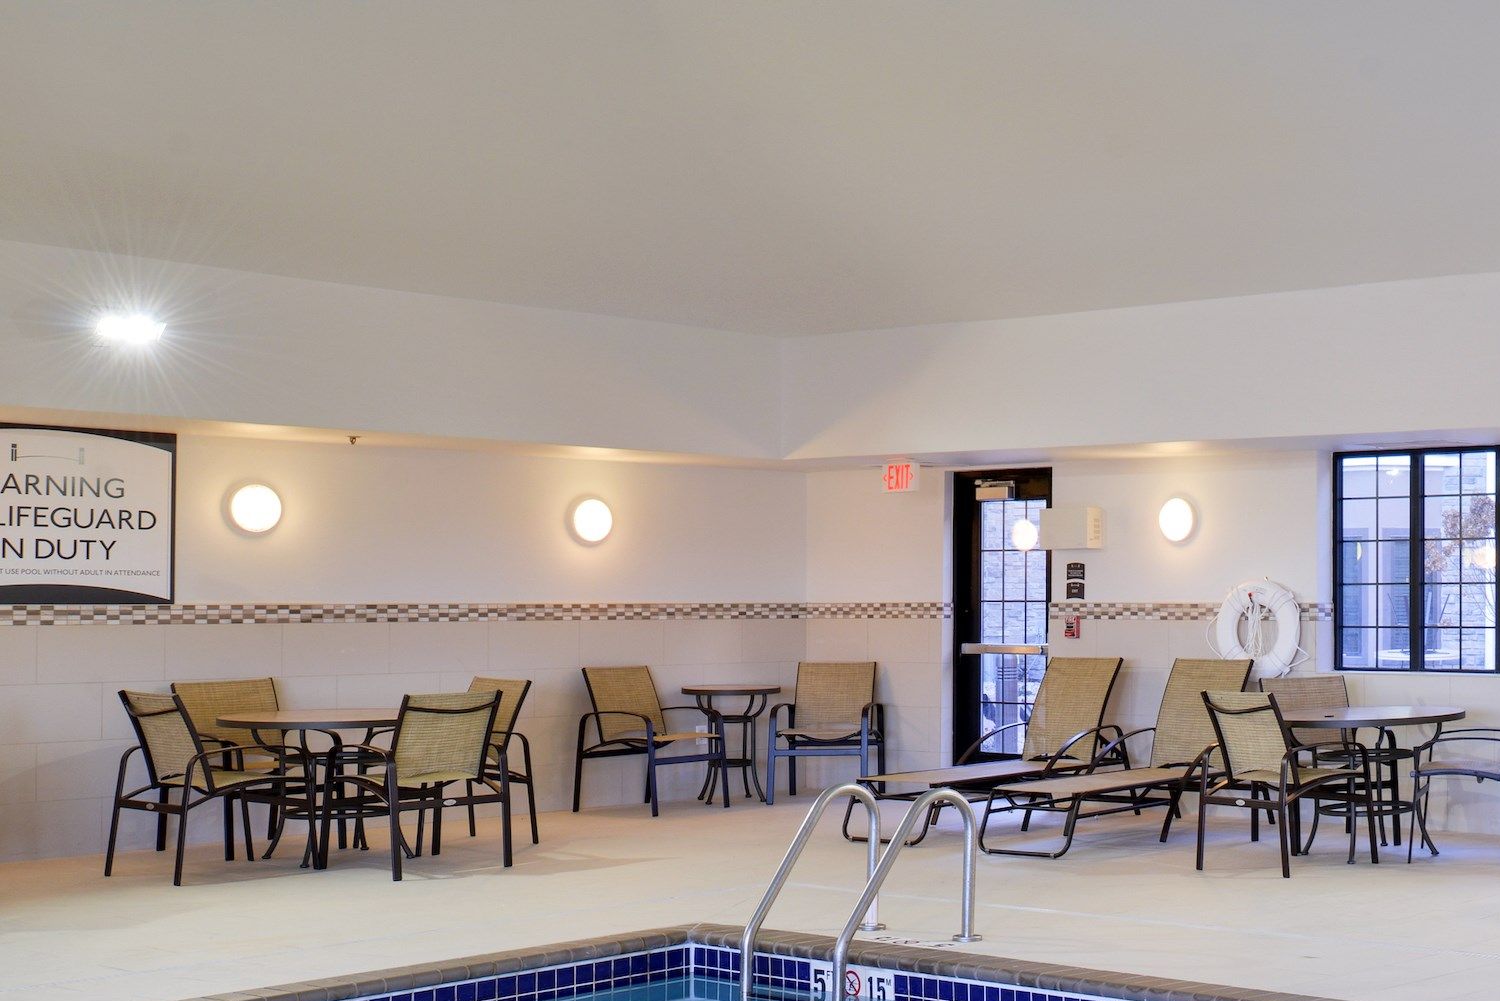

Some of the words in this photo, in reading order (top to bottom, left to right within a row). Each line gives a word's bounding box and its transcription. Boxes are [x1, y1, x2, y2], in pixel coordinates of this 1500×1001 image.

[0, 473, 125, 499] ARNING
[887, 463, 911, 491] EXIT
[35, 538, 117, 561] DUTY
[43, 568, 79, 576] WITHOUT
[113, 569, 161, 577] ATTENDANCE
[814, 969, 826, 992] 5
